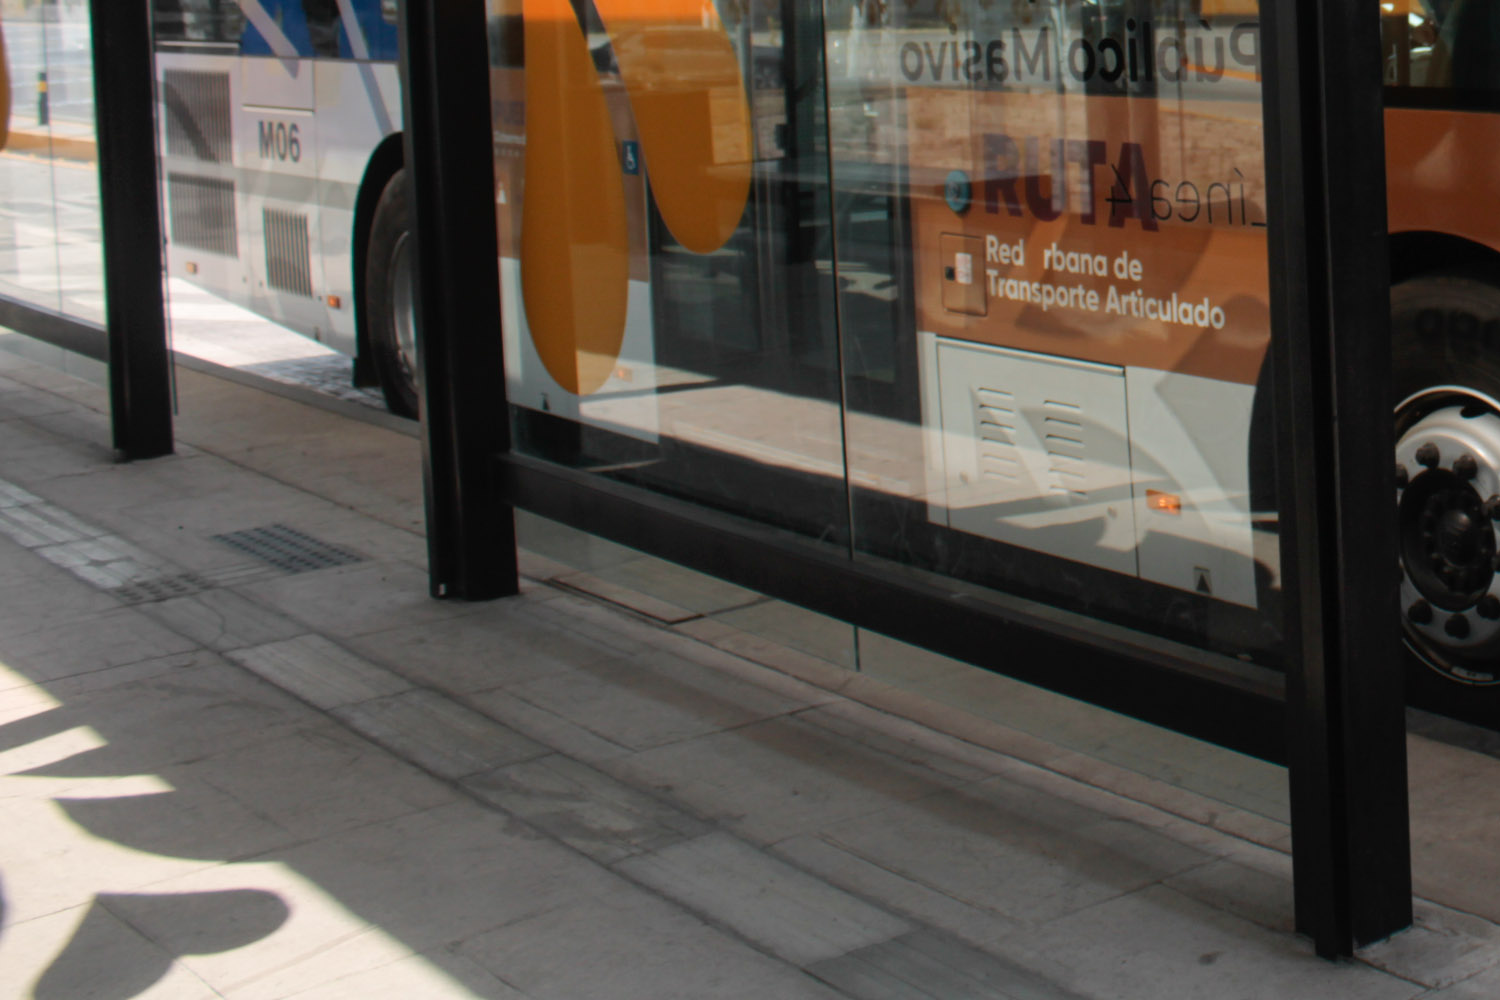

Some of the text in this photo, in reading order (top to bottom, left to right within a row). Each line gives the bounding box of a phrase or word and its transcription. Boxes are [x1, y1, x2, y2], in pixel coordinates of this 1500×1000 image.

[257, 120, 301, 163] M06
[983, 133, 1160, 232] RUTA
[985, 234, 1143, 282] Red rbana de
[985, 269, 1227, 330] Transporte Articulado
